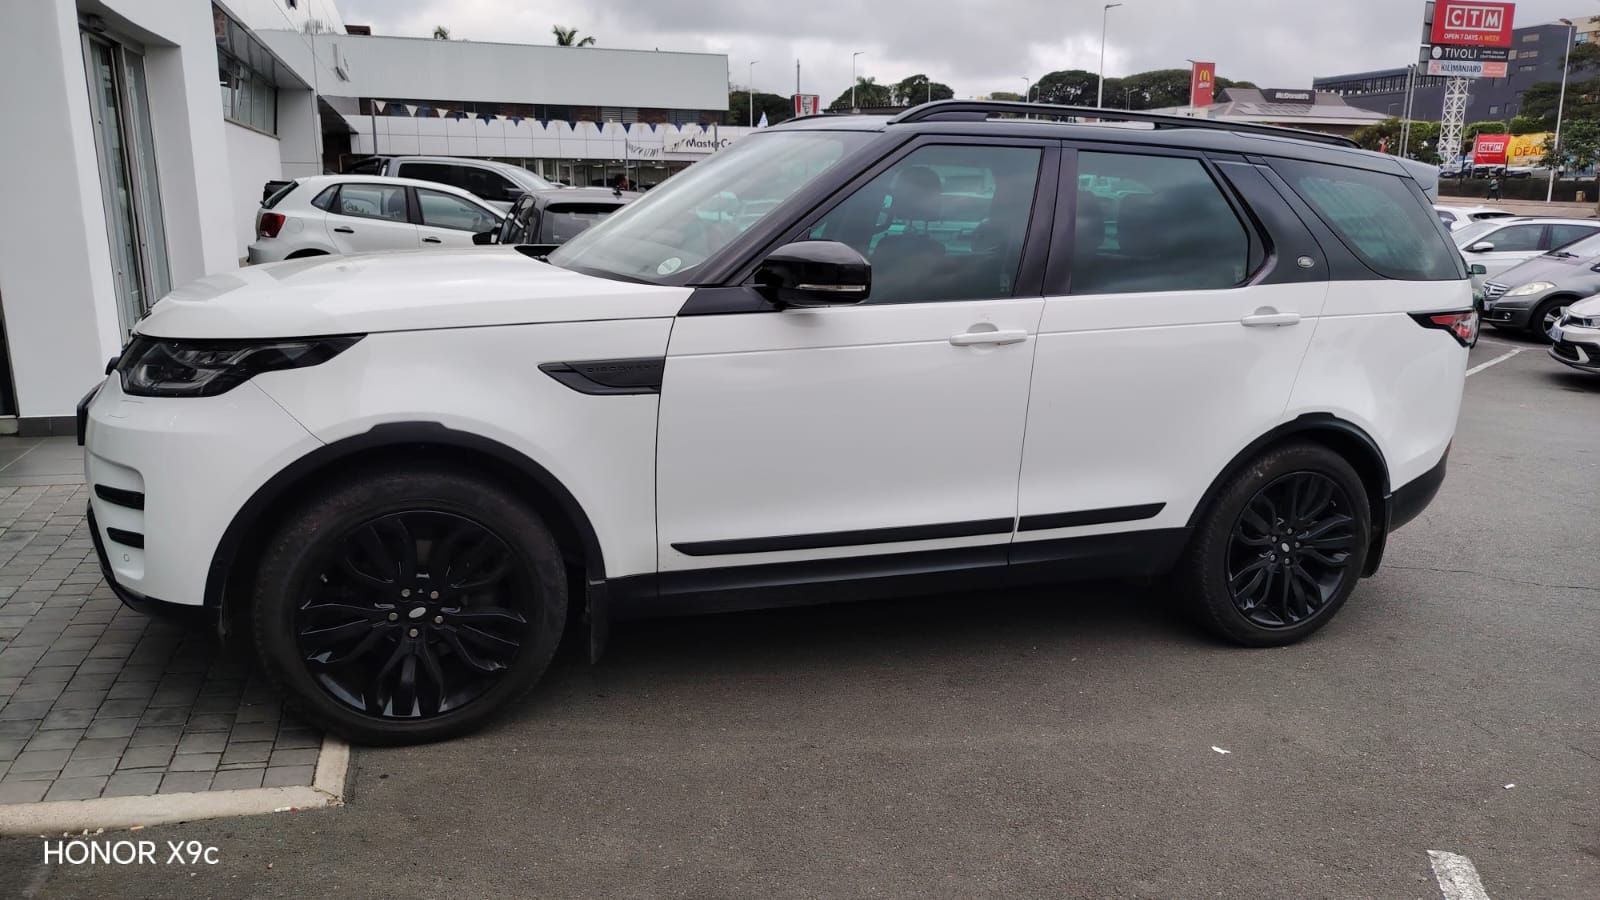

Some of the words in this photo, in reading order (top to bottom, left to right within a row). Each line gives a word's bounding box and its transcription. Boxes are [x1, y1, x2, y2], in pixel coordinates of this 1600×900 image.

[1449, 8, 1500, 28] CTM
[1444, 48, 1477, 59] TIVOLI
[1440, 63, 1482, 73] KILIMANJARO
[1479, 143, 1502, 152] CTM
